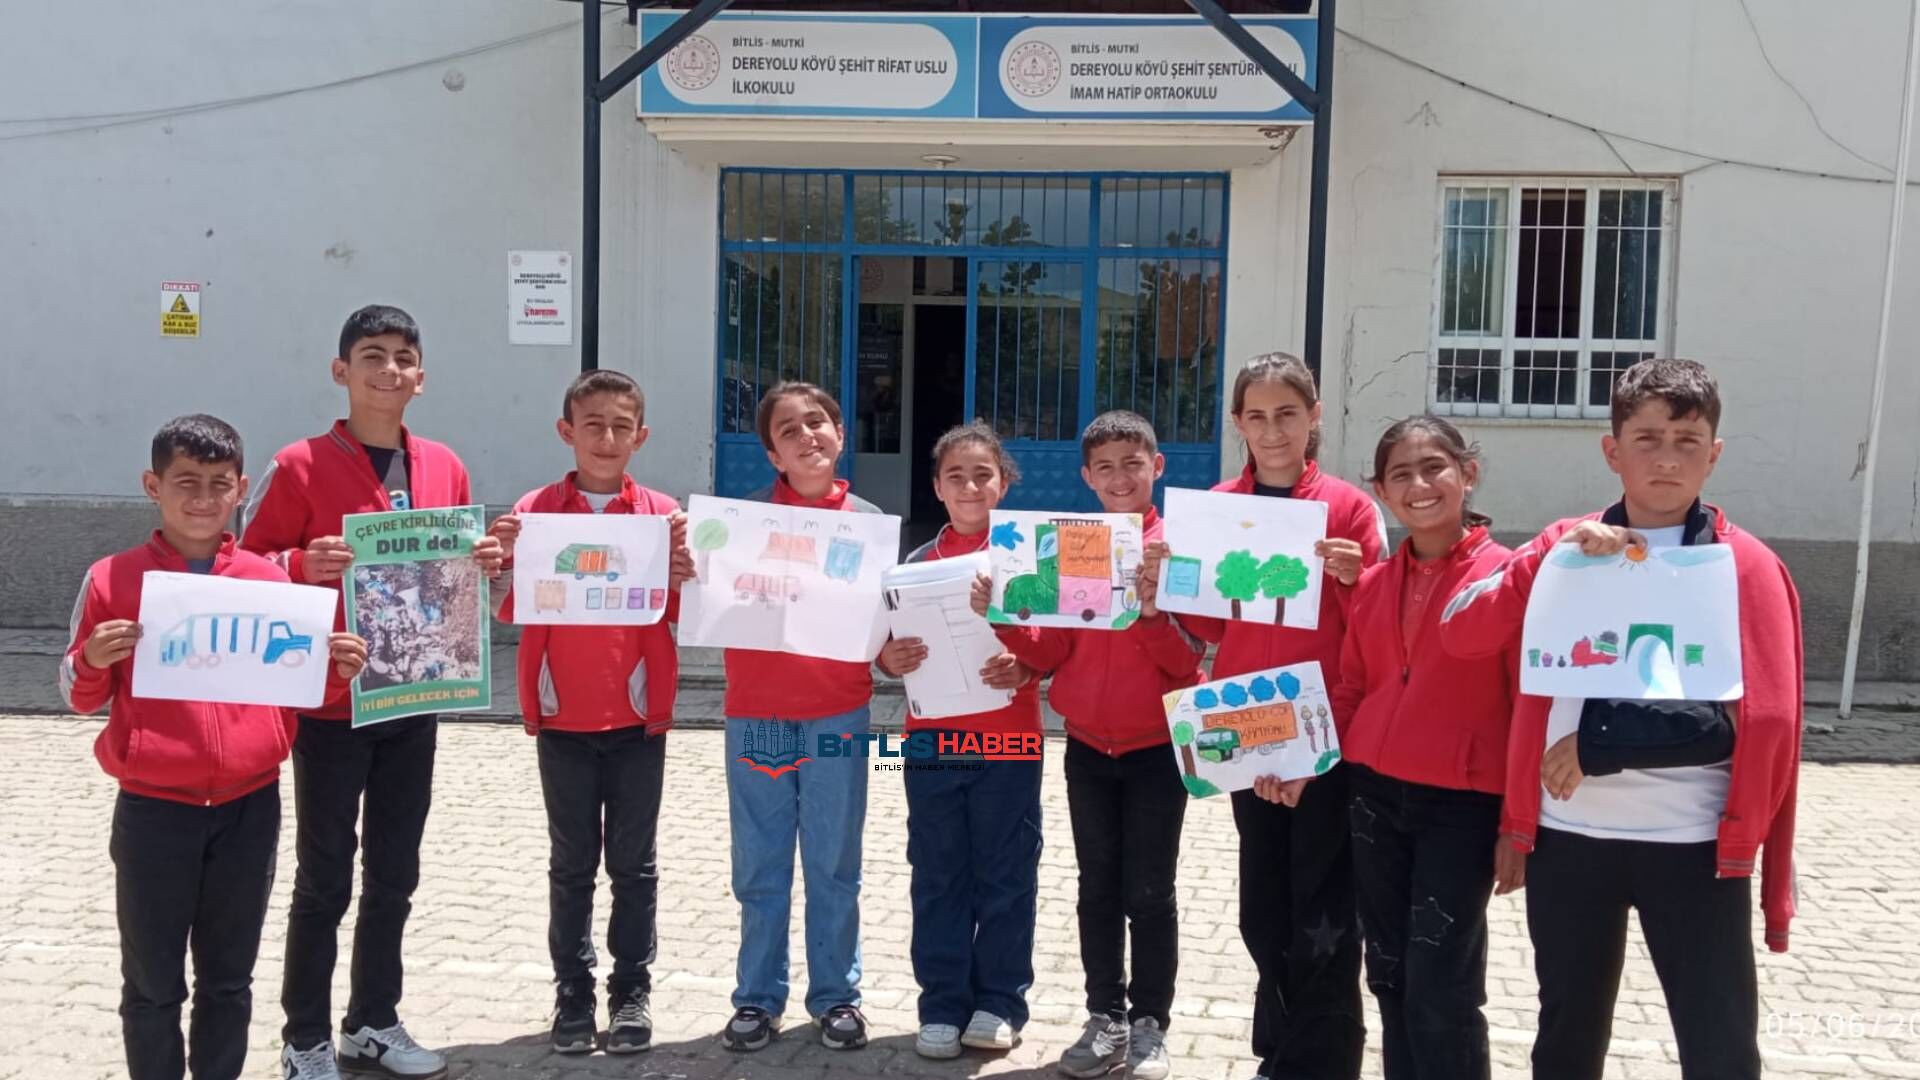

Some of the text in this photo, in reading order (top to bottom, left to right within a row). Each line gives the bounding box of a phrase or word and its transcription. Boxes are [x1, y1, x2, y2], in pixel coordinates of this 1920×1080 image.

[732, 37, 764, 47] BİTLİS
[771, 37, 805, 49] MUTKİ
[1071, 44, 1100, 54] BİTLİS
[1107, 43, 1139, 54] MUTKİ
[732, 55, 947, 76] DEREYOLU KÖYÜ ŞEHİT RİFAT USLU
[1070, 62, 1133, 76] DEREYOLU
[1135, 61, 1168, 77] KÖYÜ
[1171, 61, 1205, 79] ŞEHİT
[732, 78, 796, 95] İLKOKULU
[1070, 86, 1218, 100] İMAM HATİP ORTAOKULU
[355, 510, 476, 541] ÇEVRE KİRLİLİĞİNE
[376, 534, 458, 555] DUR de!
[376, 696, 395, 710] BİR
[397, 689, 450, 705] GELECEK
[454, 686, 480, 701] İÇİN
